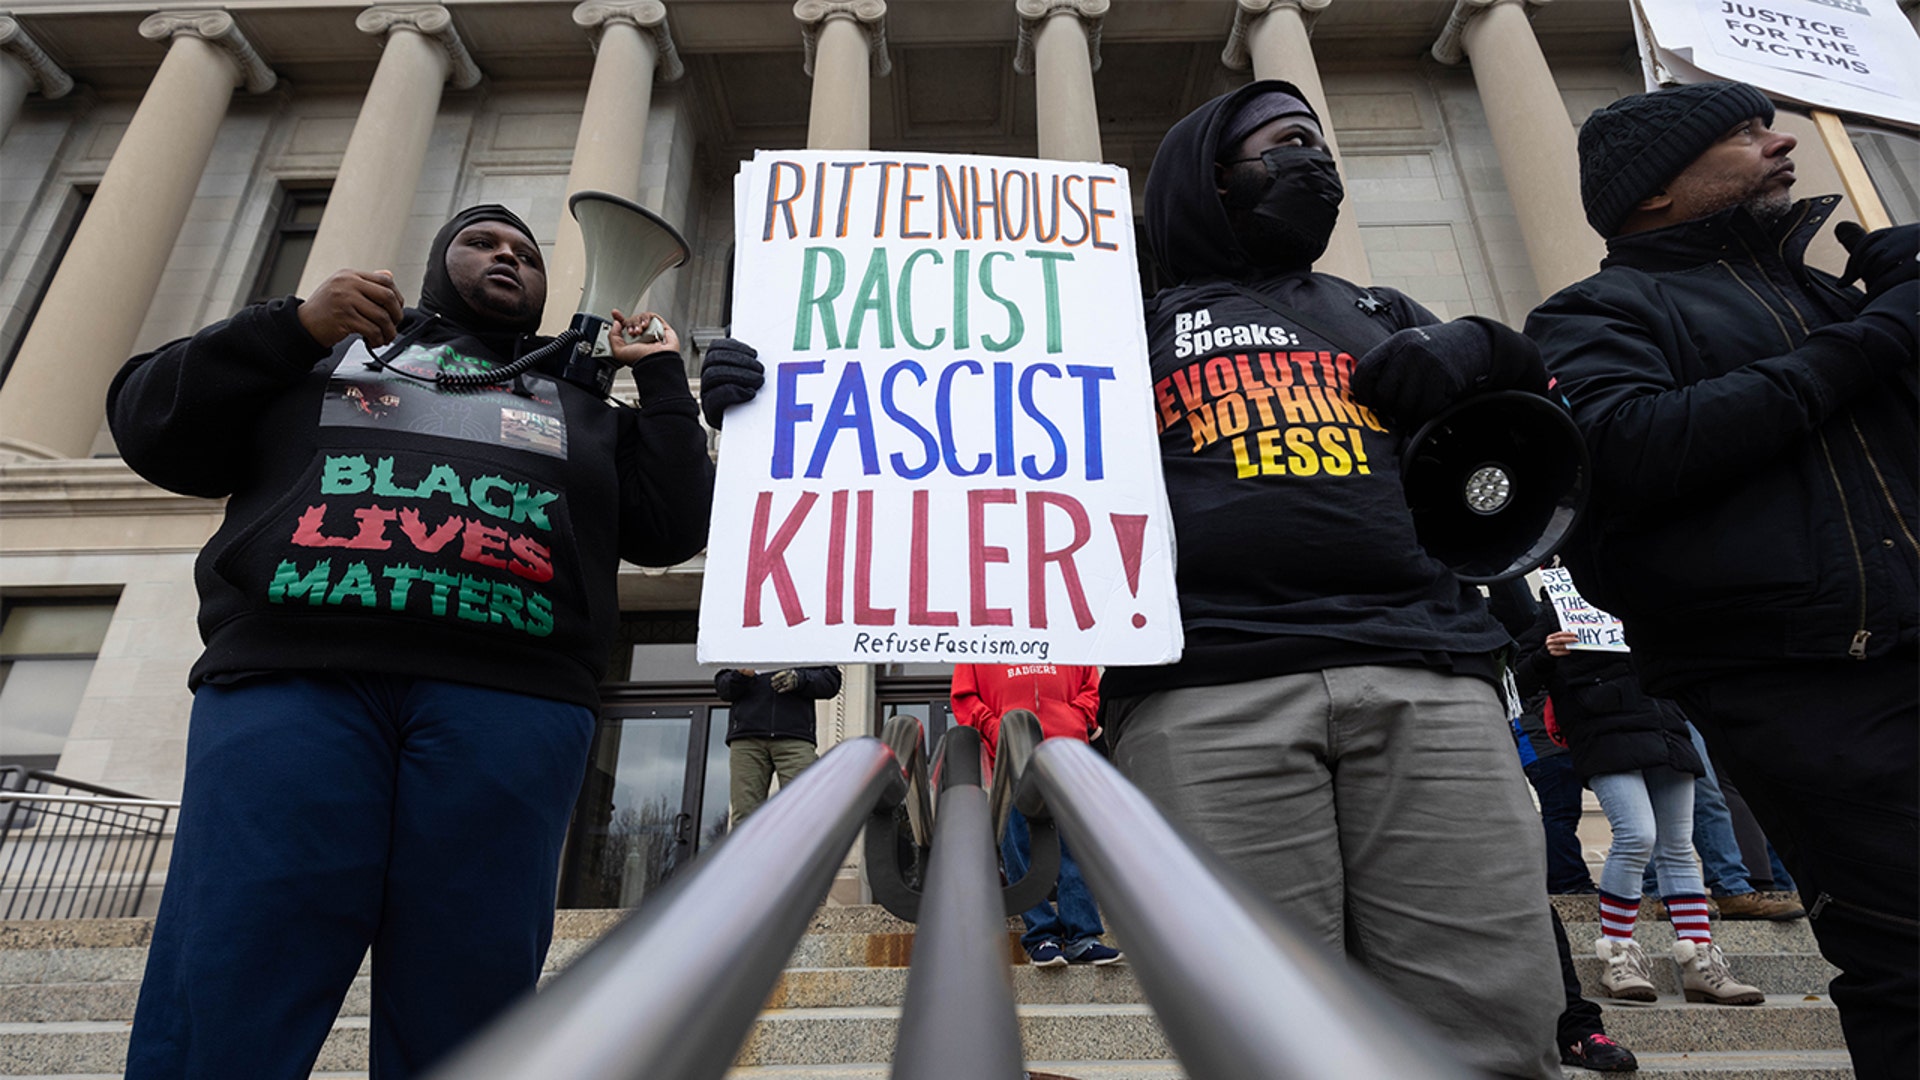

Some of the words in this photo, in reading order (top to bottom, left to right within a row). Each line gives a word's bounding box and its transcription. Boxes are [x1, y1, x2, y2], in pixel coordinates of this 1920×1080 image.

[1721, 1, 1848, 40] JUSTICE
[1725, 19, 1787, 41] FOR
[1796, 34, 1860, 57] THE
[1730, 34, 1870, 75] VICTIMS
[762, 161, 1118, 251] RITTENHOUSE
[793, 246, 1075, 354] RACIST
[1175, 309, 1212, 335] BA
[1175, 324, 1299, 359] Speaks:
[771, 360, 1116, 481] FASCIST
[1156, 352, 1359, 436] EVOLUTIO
[1231, 426, 1371, 479] LESS!
[321, 454, 559, 531] BLACK
[291, 503, 554, 582] LIVES
[743, 488, 1148, 631] KILLER!
[268, 557, 554, 637] MATTERS
[1556, 596, 1589, 610] THE
[854, 633, 1049, 660] RefuseFascism.org
[1007, 665, 1057, 678] BADGERS
